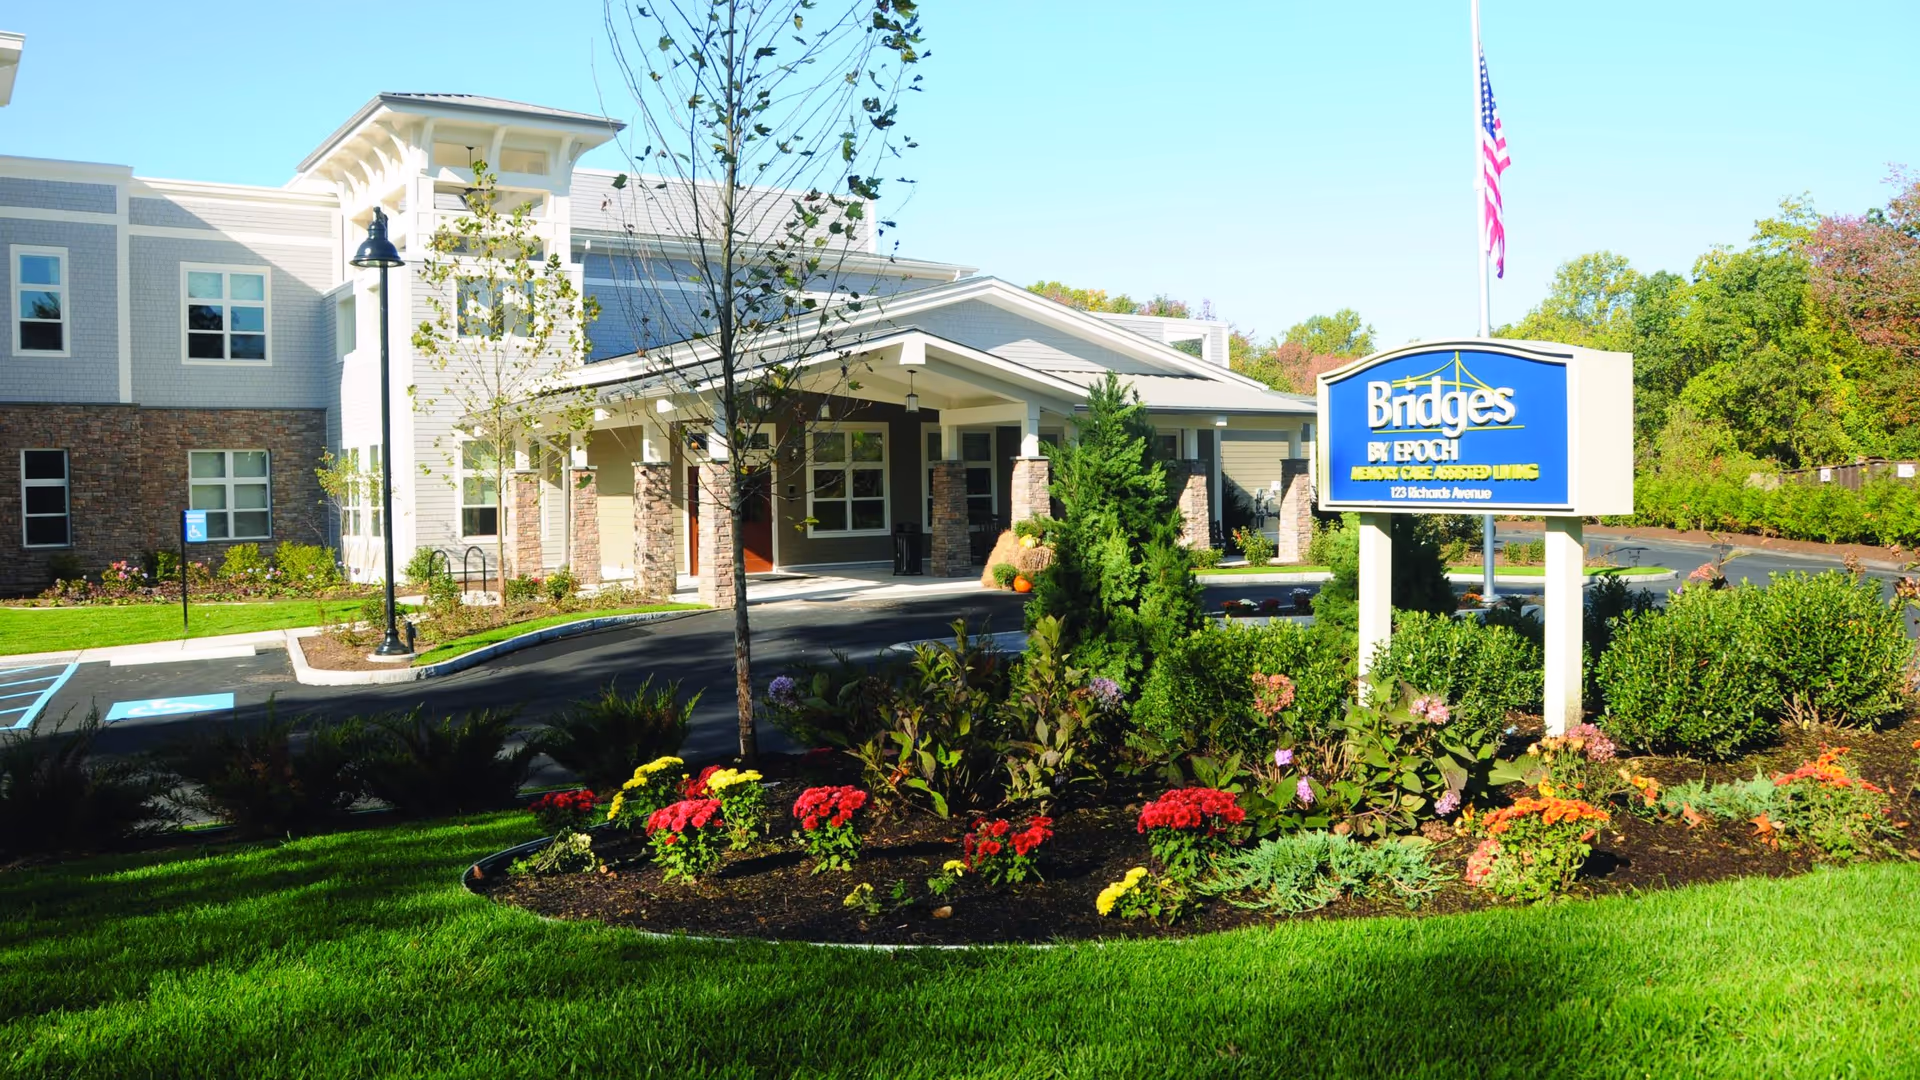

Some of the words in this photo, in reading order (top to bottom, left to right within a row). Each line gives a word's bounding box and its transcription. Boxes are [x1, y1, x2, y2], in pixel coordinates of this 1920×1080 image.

[1368, 376, 1516, 438] Bridges
[1368, 441, 1391, 463] BY
[1394, 438, 1459, 462] EPOCH
[1351, 466, 1399, 481] MEMORY
[1400, 466, 1433, 480] CARE
[1433, 465, 1492, 480] ASSISTED
[1493, 464, 1539, 480] LIVING
[1390, 486, 1407, 498] 123
[1408, 486, 1451, 499] Richards
[1452, 487, 1492, 499] Avenue
